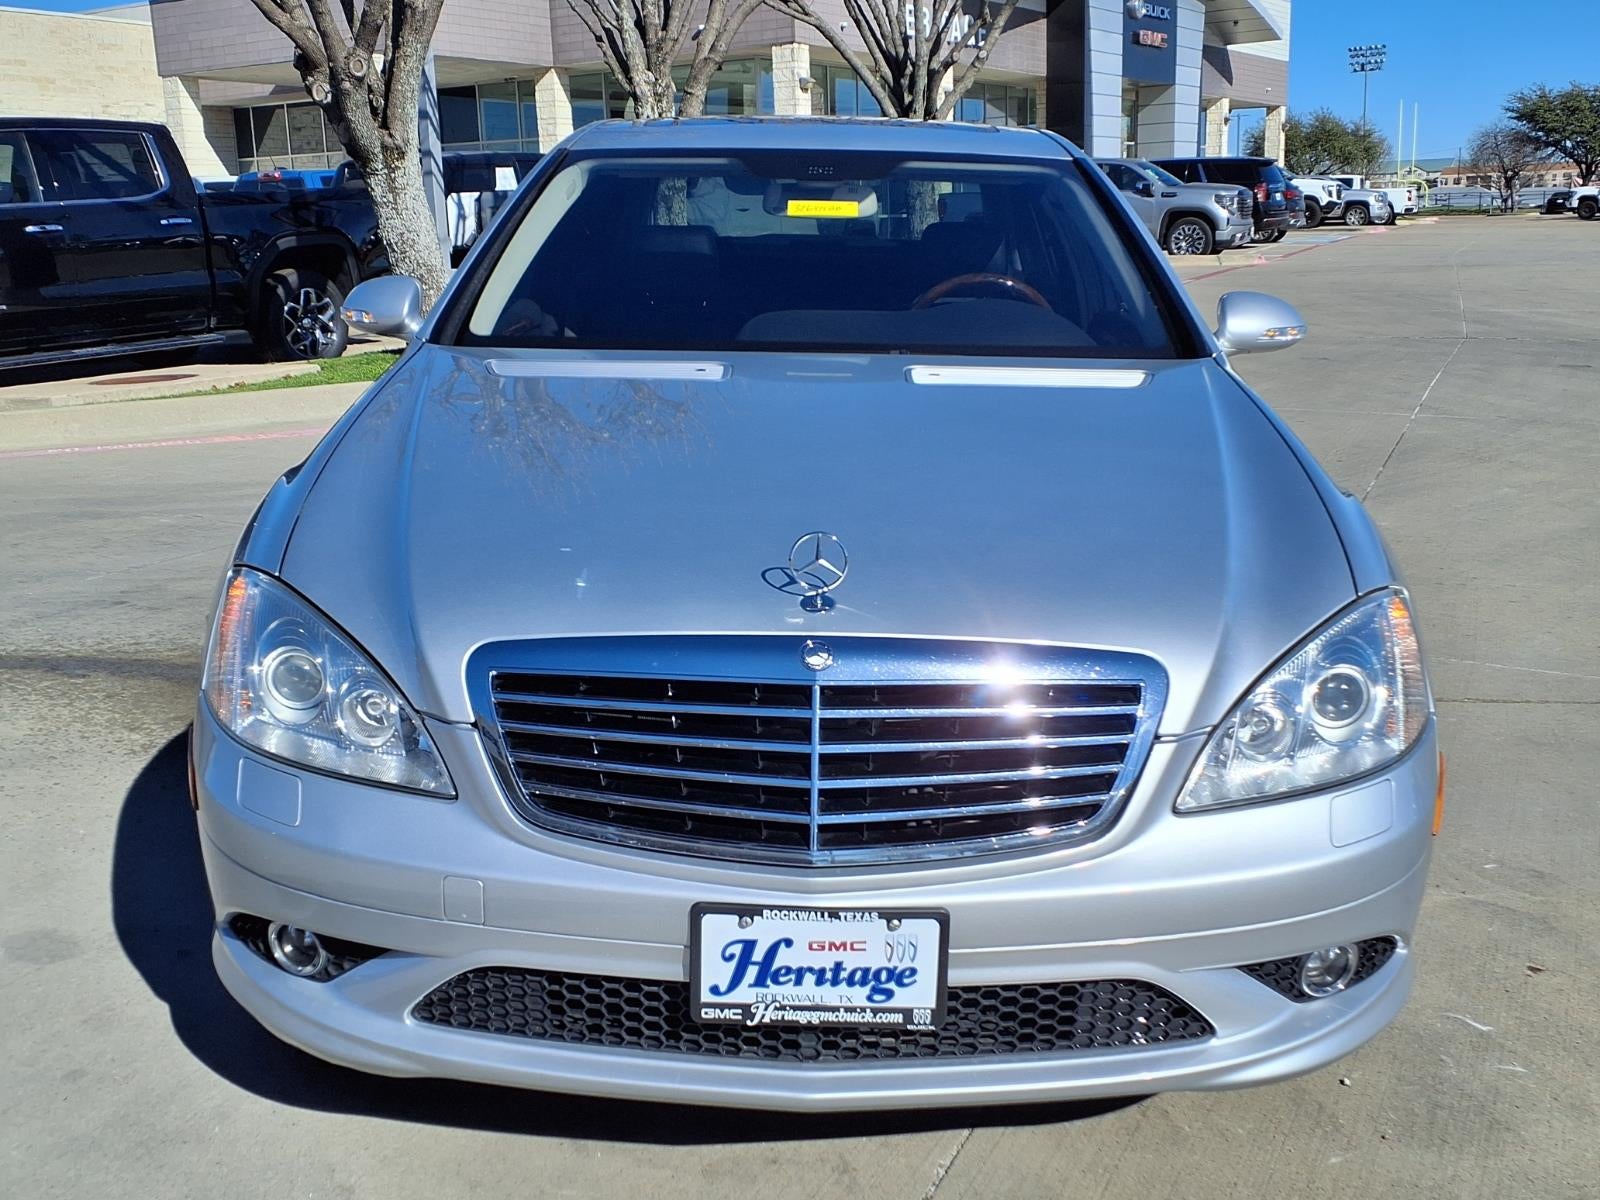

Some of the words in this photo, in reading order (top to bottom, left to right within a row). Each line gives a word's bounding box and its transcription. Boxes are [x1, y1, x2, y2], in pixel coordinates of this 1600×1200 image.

[1144, 3, 1171, 19] BUICK
[1139, 29, 1168, 48] GMC
[762, 909, 834, 923] ROCKWALL,
[838, 912, 879, 922] TEXAS
[808, 940, 867, 952] GMC
[708, 937, 918, 1004] Heritage
[837, 994, 854, 1004] TX
[701, 1007, 742, 1019] GMC
[746, 1001, 904, 1026] Heritagegmcbuick.com
